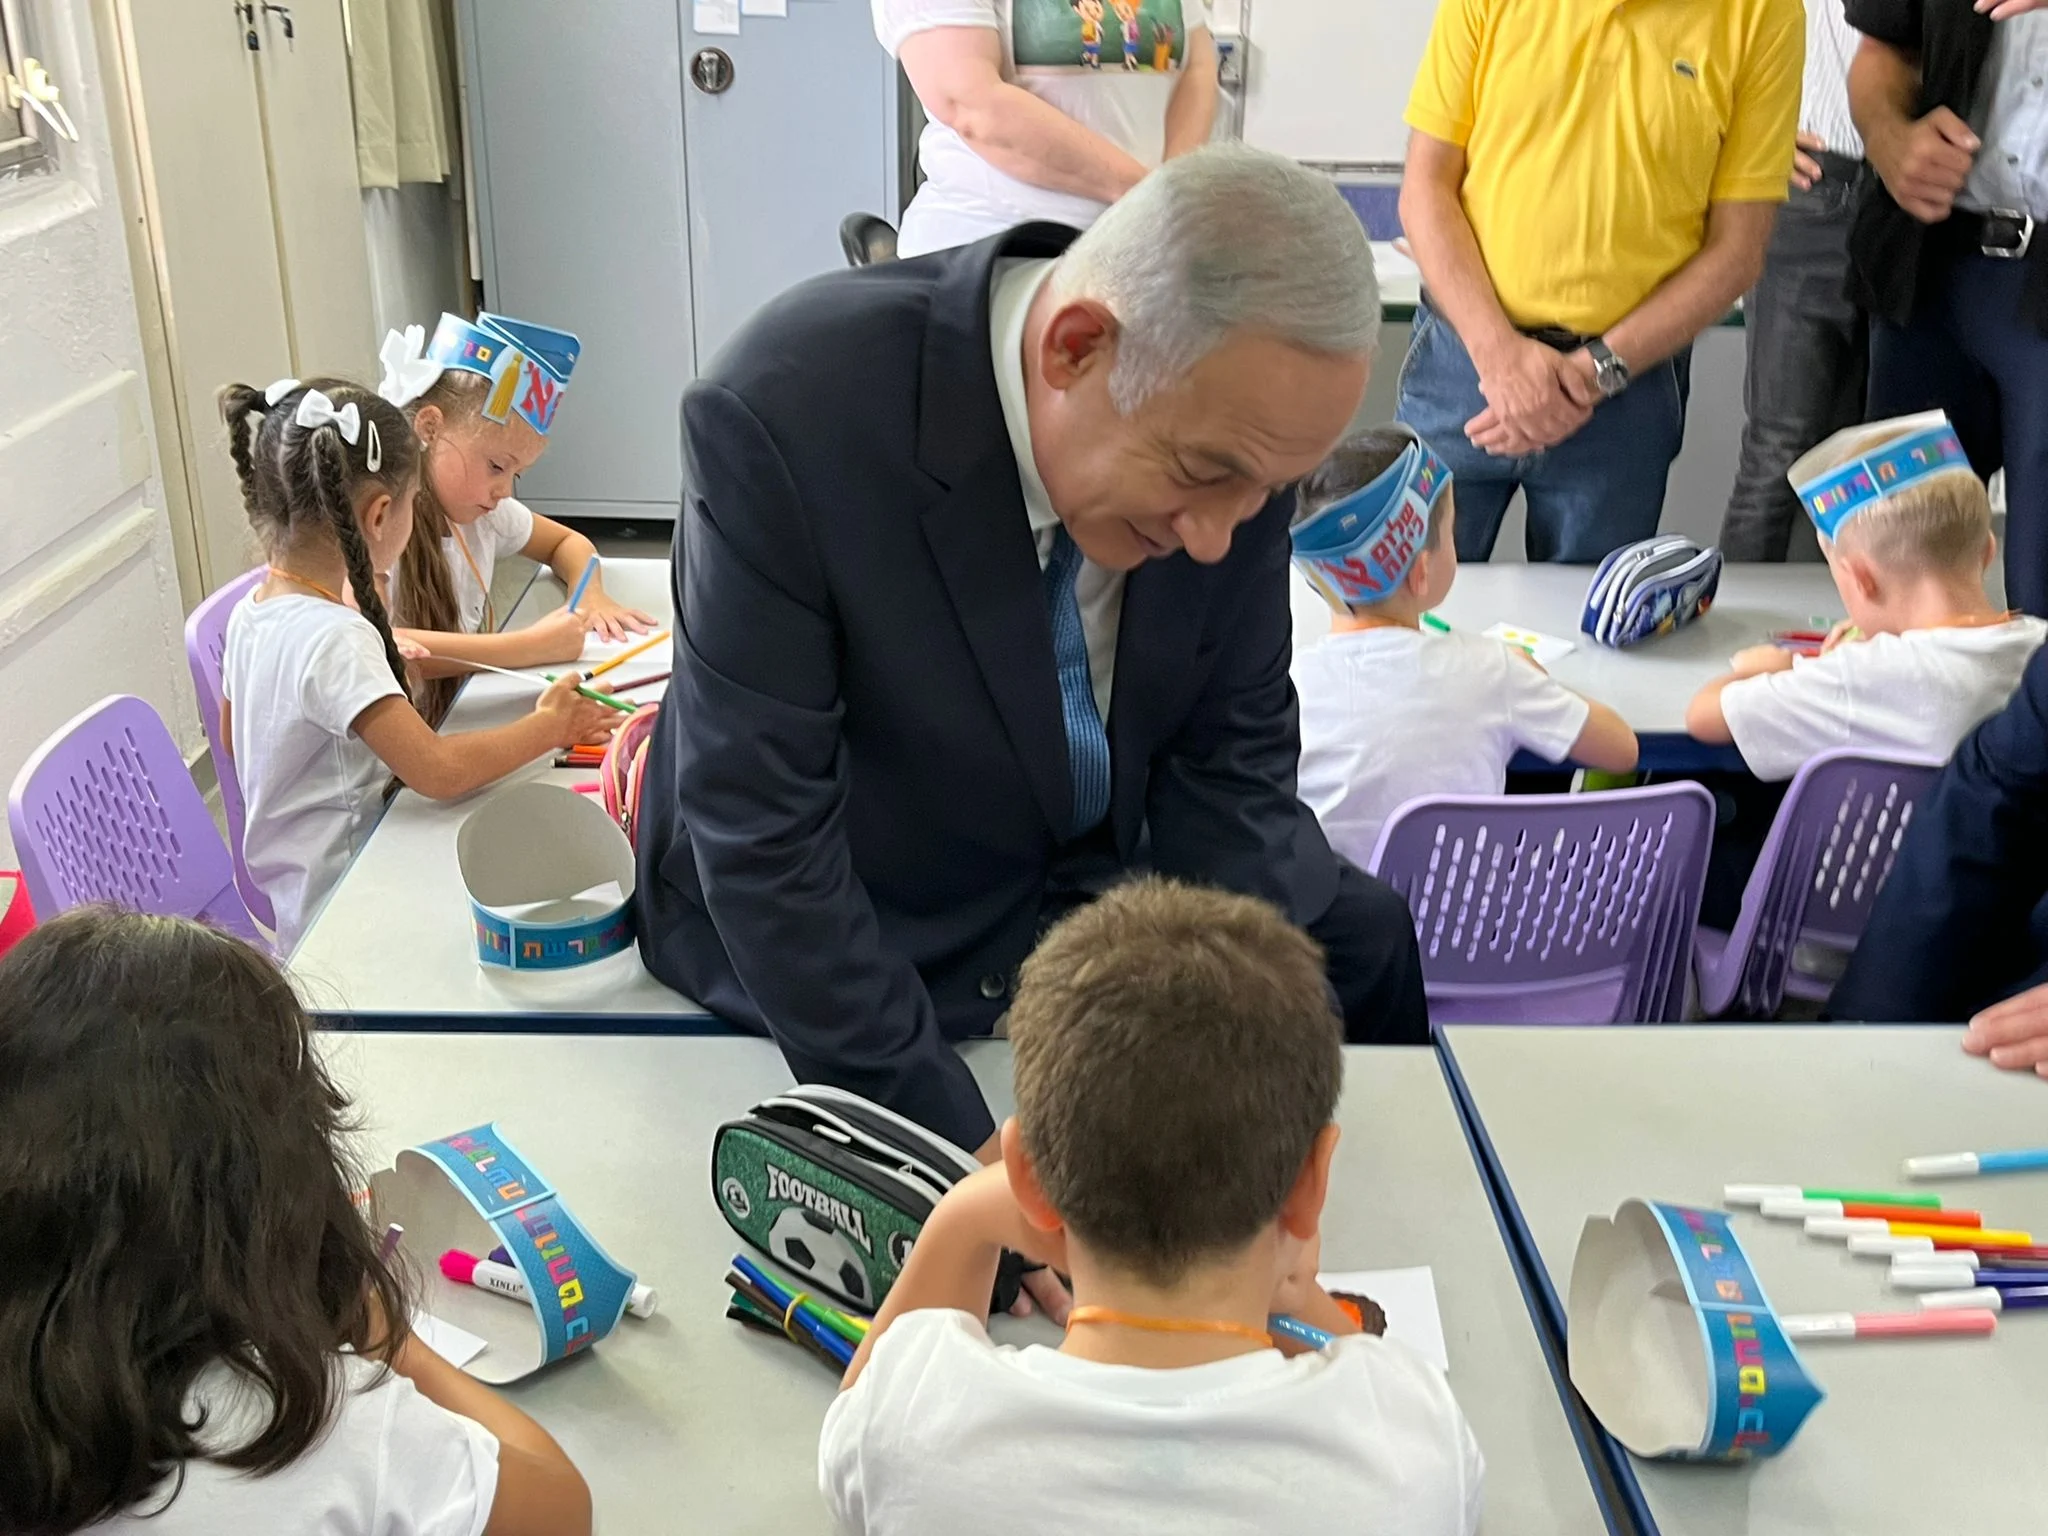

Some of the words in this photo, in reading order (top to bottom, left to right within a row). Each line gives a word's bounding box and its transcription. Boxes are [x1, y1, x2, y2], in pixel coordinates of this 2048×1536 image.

[1370, 498, 1415, 565] שלום
[1383, 513, 1424, 582] כיתה
[767, 1163, 873, 1256] FOOTBALL
